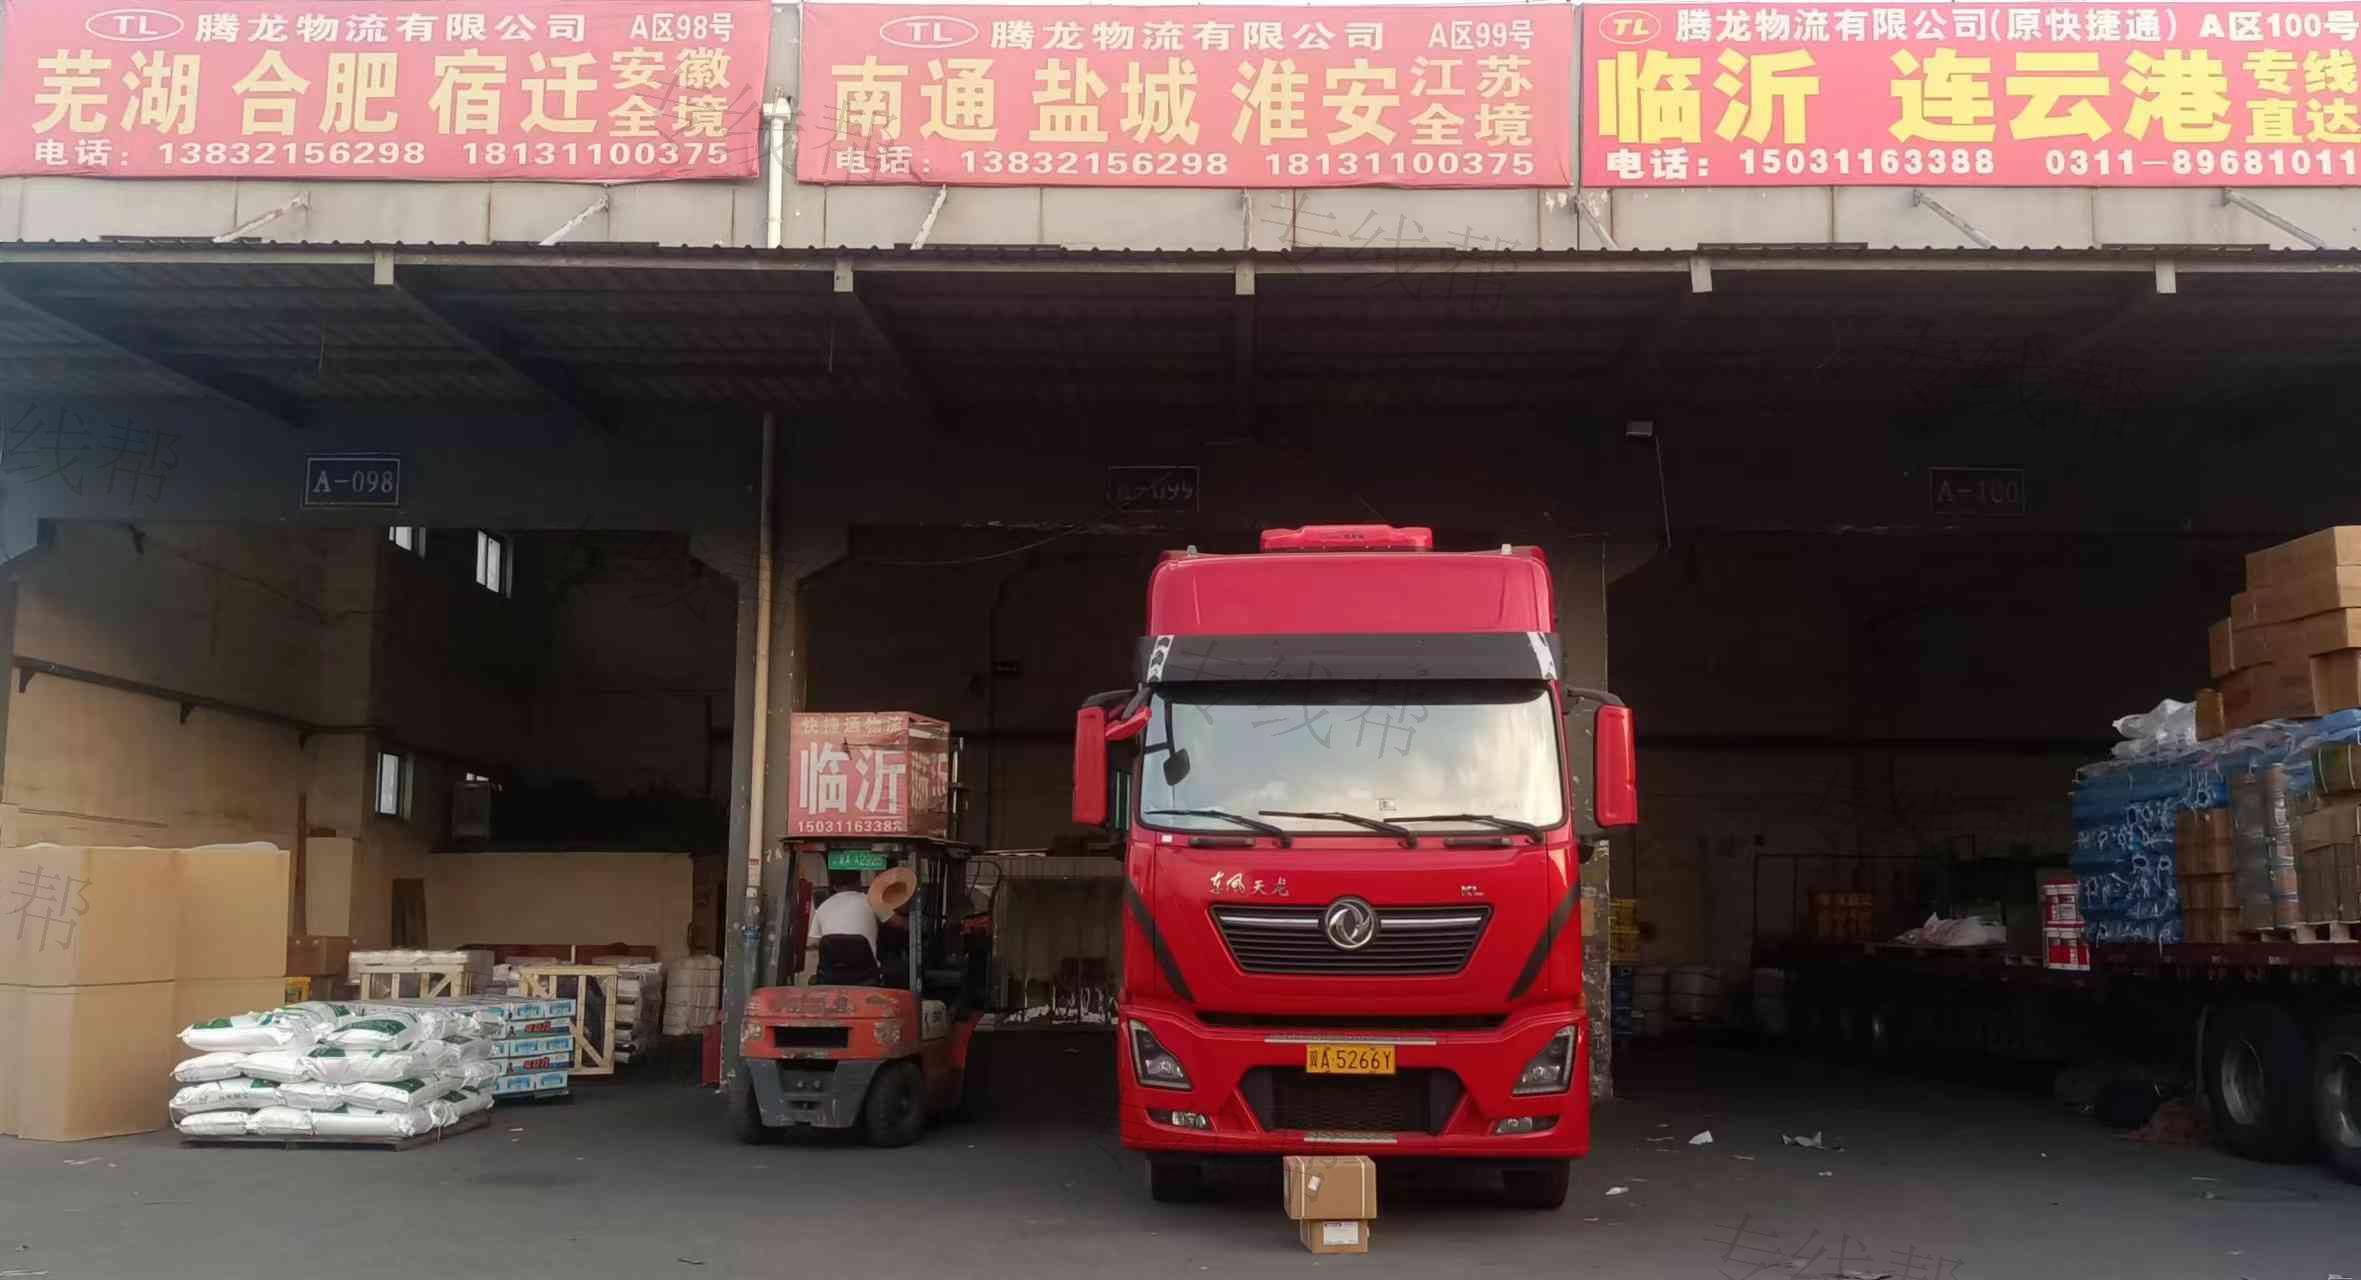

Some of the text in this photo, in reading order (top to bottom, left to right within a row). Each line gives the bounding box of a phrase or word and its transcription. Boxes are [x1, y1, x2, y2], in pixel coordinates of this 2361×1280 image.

[113, 15, 160, 35] TL
[194, 12, 735, 43] 腾龙物流有限公司 A区98号
[904, 21, 952, 44] TL
[990, 19, 1536, 51] 腾龙物流有限公司 A区99号
[1611, 18, 1651, 36] TL
[2199, 10, 2361, 41] A区100号
[609, 46, 733, 90] 安徽
[1410, 53, 1534, 99] 江苏
[2242, 48, 2360, 95] 专线
[31, 47, 599, 136] 芜湖 合肥 宿迁
[831, 55, 1402, 146] 南通 盐城 淮安
[1597, 47, 2233, 145] 临沂 连云港
[607, 94, 730, 138] 全境
[1408, 102, 1534, 147] 全境
[2245, 97, 2361, 144] 直达
[158, 141, 427, 165] 13832156298
[463, 141, 730, 166] 18131100375
[960, 150, 1229, 175] 13832156298
[1264, 150, 1535, 176] 18131100375
[1738, 148, 1995, 176] 15031163388
[311, 469, 394, 494] A-098
[799, 741, 906, 815] 临沂
